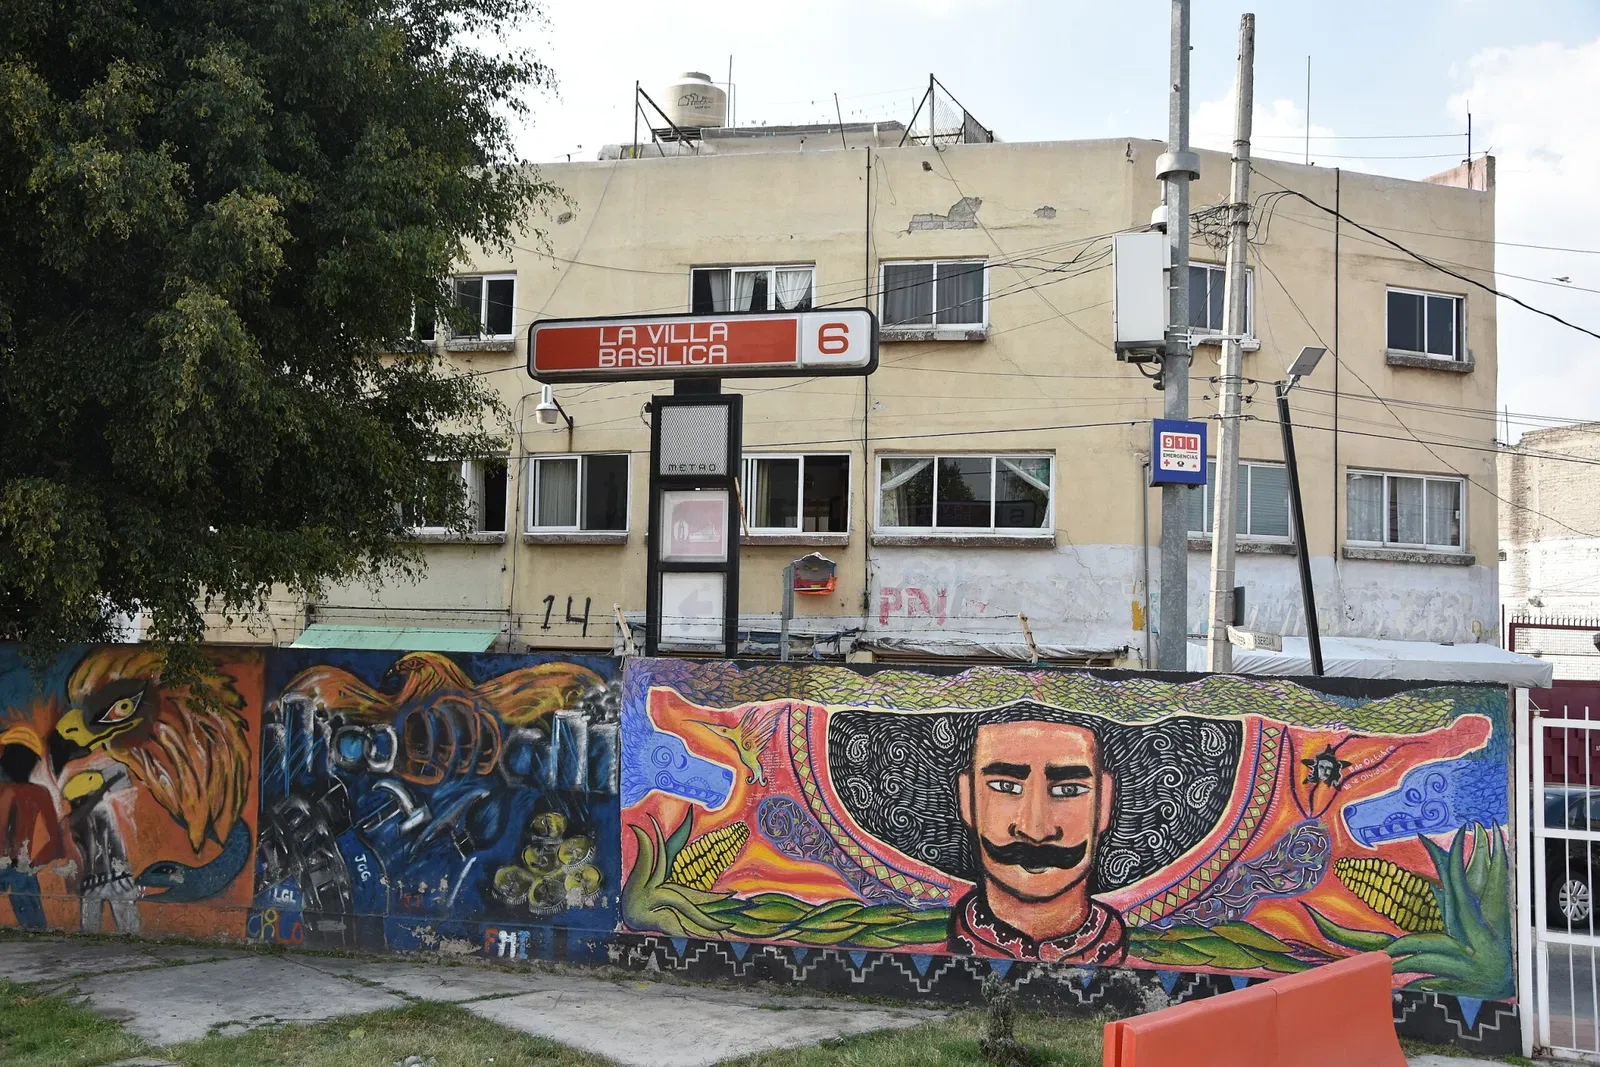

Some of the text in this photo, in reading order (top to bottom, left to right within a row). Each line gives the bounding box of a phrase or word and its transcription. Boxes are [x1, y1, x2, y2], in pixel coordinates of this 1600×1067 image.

[599, 323, 728, 346] LA VILLA
[817, 322, 849, 354] 6
[598, 345, 727, 368] BASILICA
[1164, 437, 1196, 449] 911
[668, 463, 716, 472] METRO
[541, 595, 591, 638] 14
